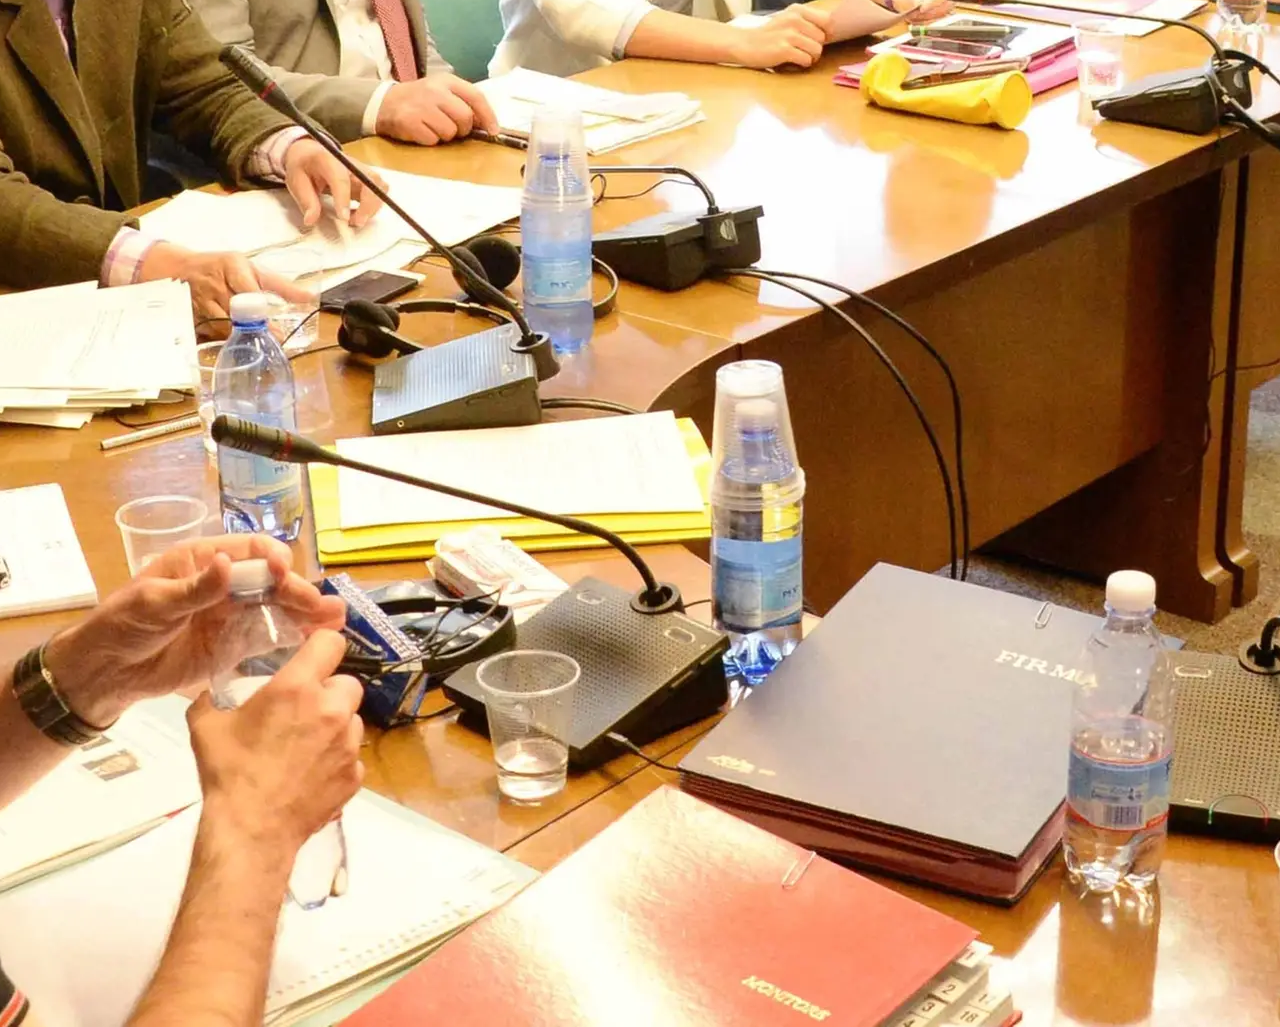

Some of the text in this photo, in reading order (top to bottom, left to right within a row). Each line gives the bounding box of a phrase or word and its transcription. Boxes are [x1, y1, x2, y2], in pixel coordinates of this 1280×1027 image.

[994, 649, 1099, 691] FIRMA
[943, 983, 957, 994] 2
[922, 1001, 935, 1012] 3
[959, 1009, 980, 1023] 18
